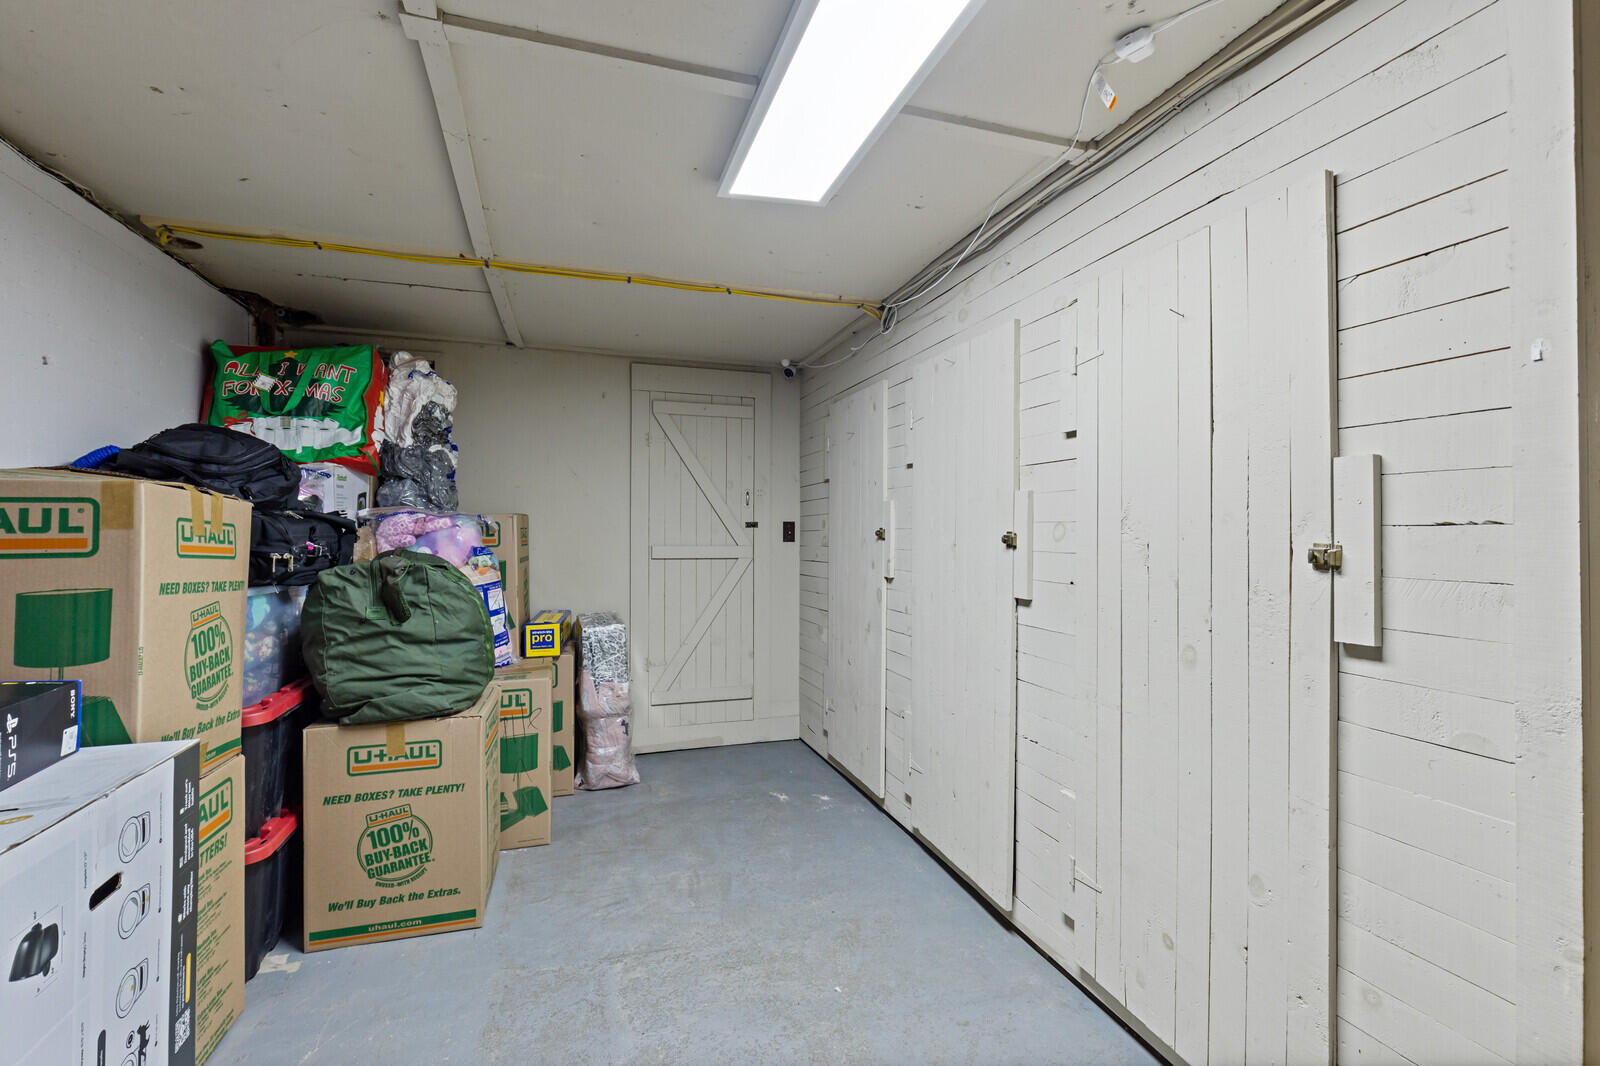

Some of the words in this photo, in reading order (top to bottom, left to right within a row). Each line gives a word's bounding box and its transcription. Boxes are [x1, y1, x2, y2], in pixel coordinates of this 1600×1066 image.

[278, 362, 289, 376] I
[159, 582, 181, 595] NEED
[182, 581, 210, 594] BOXES?
[211, 581, 227, 593] TAKE
[191, 622, 226, 659] 100%
[532, 634, 552, 644] pro
[190, 646, 230, 682] BUY-BACK
[182, 727, 196, 740] Buy
[196, 717, 214, 735] Back
[215, 714, 226, 728] the
[323, 794, 351, 806] NEED
[354, 789, 395, 803] BOXES?
[398, 787, 423, 798] TAKE
[425, 783, 465, 795] PLENTY!
[369, 807, 409, 822] U-HAUL
[366, 820, 420, 849] 100%
[364, 838, 428, 867] BUY-BACK
[328, 901, 353, 912] We'll
[356, 898, 376, 910] Buy
[379, 894, 405, 906] Back
[408, 891, 424, 901] the
[427, 887, 461, 899] Extras.
[368, 919, 422, 933] uhaul.com
